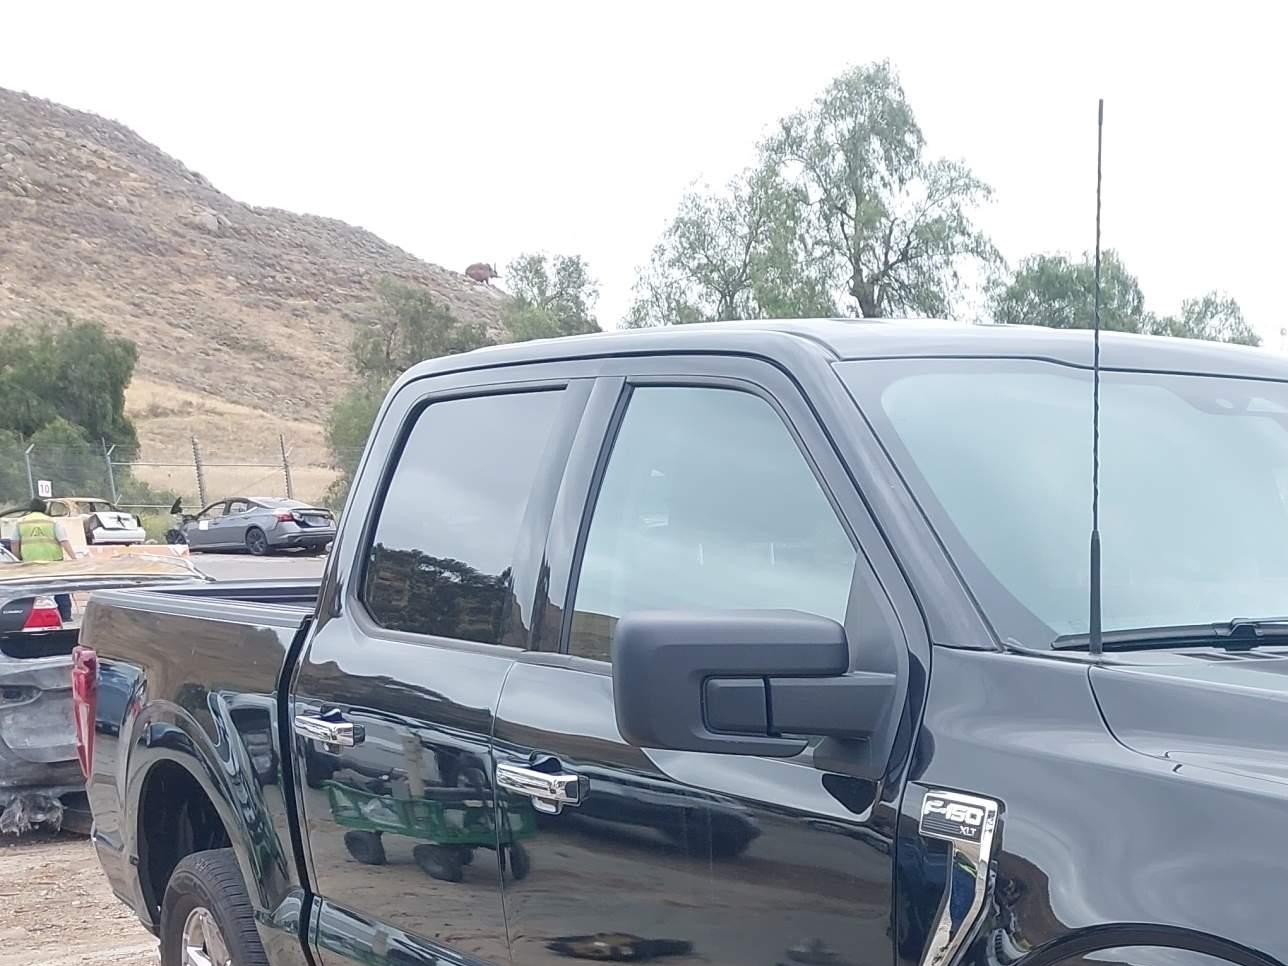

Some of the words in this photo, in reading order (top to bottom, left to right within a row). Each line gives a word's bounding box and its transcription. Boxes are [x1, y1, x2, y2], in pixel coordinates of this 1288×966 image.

[40, 484, 50, 494] 10
[923, 800, 984, 825] F-150
[959, 825, 977, 837] XLT
